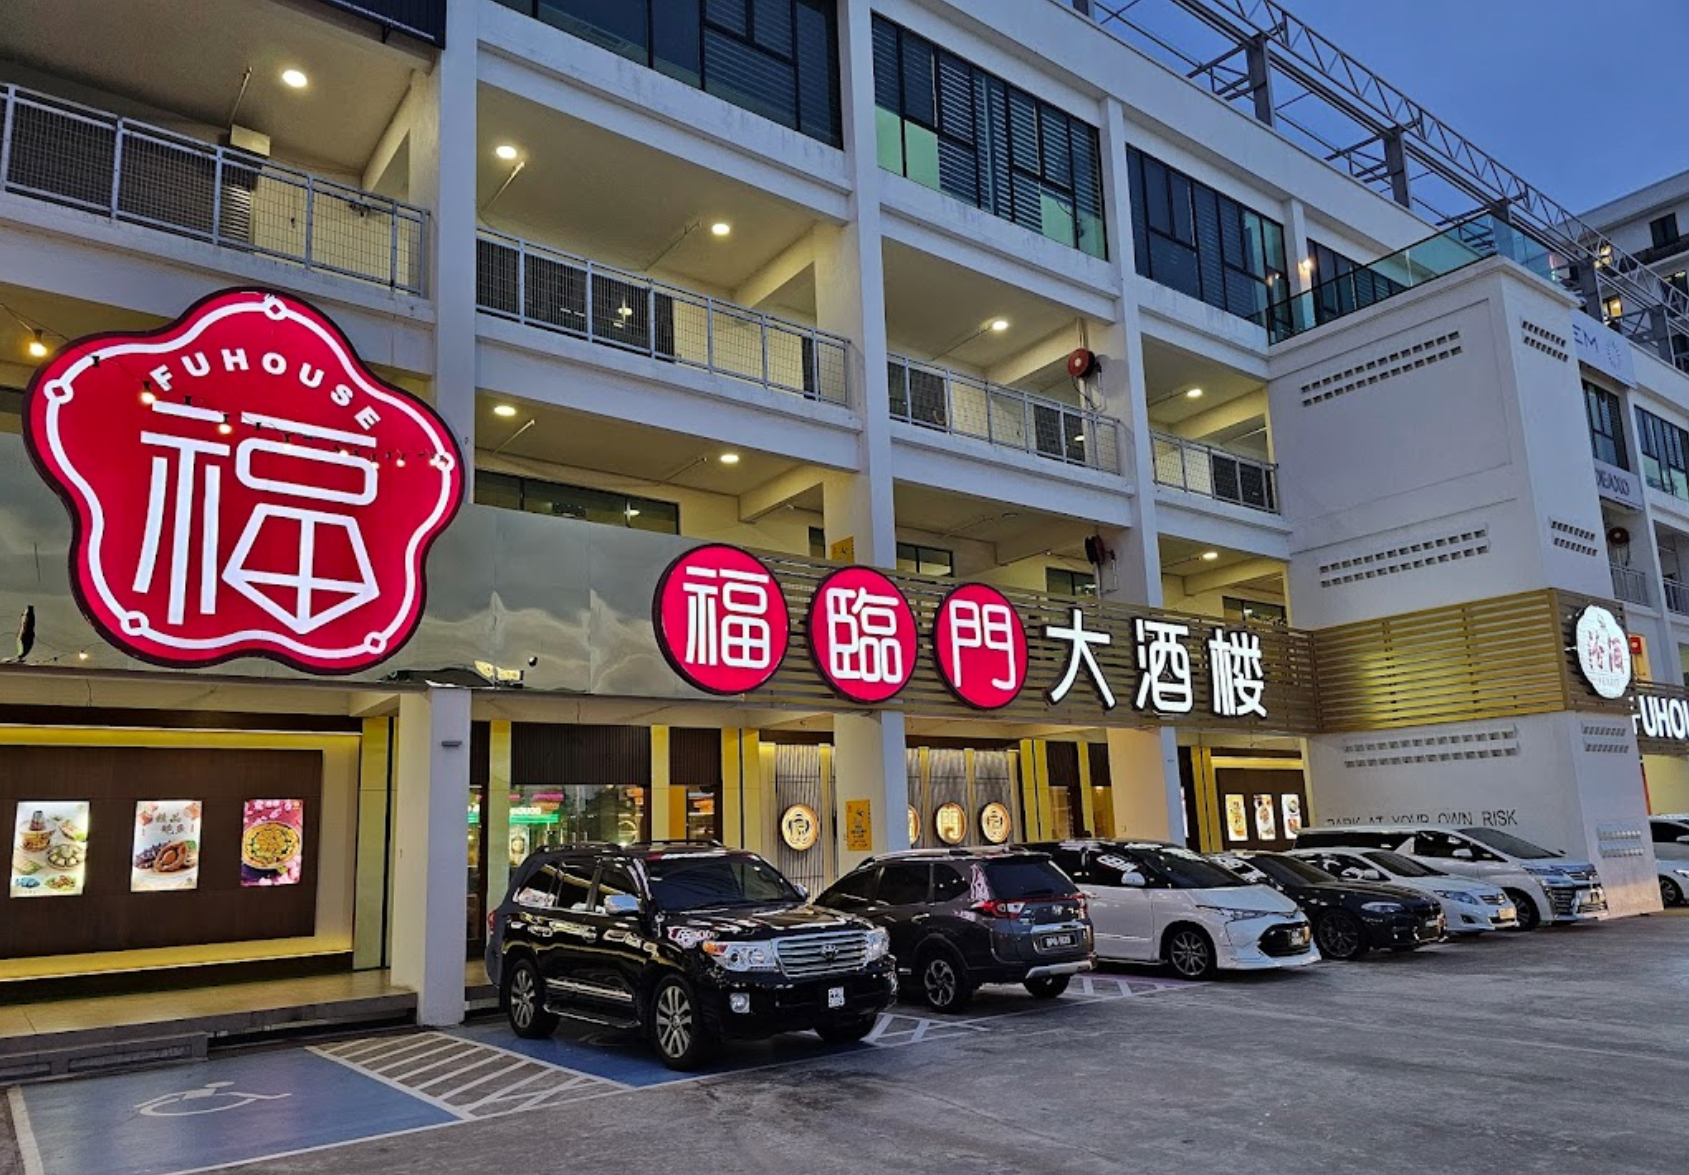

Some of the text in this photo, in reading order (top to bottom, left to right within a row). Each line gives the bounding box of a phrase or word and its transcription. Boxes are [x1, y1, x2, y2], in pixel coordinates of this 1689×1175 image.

[150, 348, 380, 430] FUHOUSE
[132, 400, 380, 634] 福
[684, 566, 1268, 717] 福臨門大酒楼
[1438, 812, 1474, 826] OWN
[1482, 809, 1519, 827] RISK
